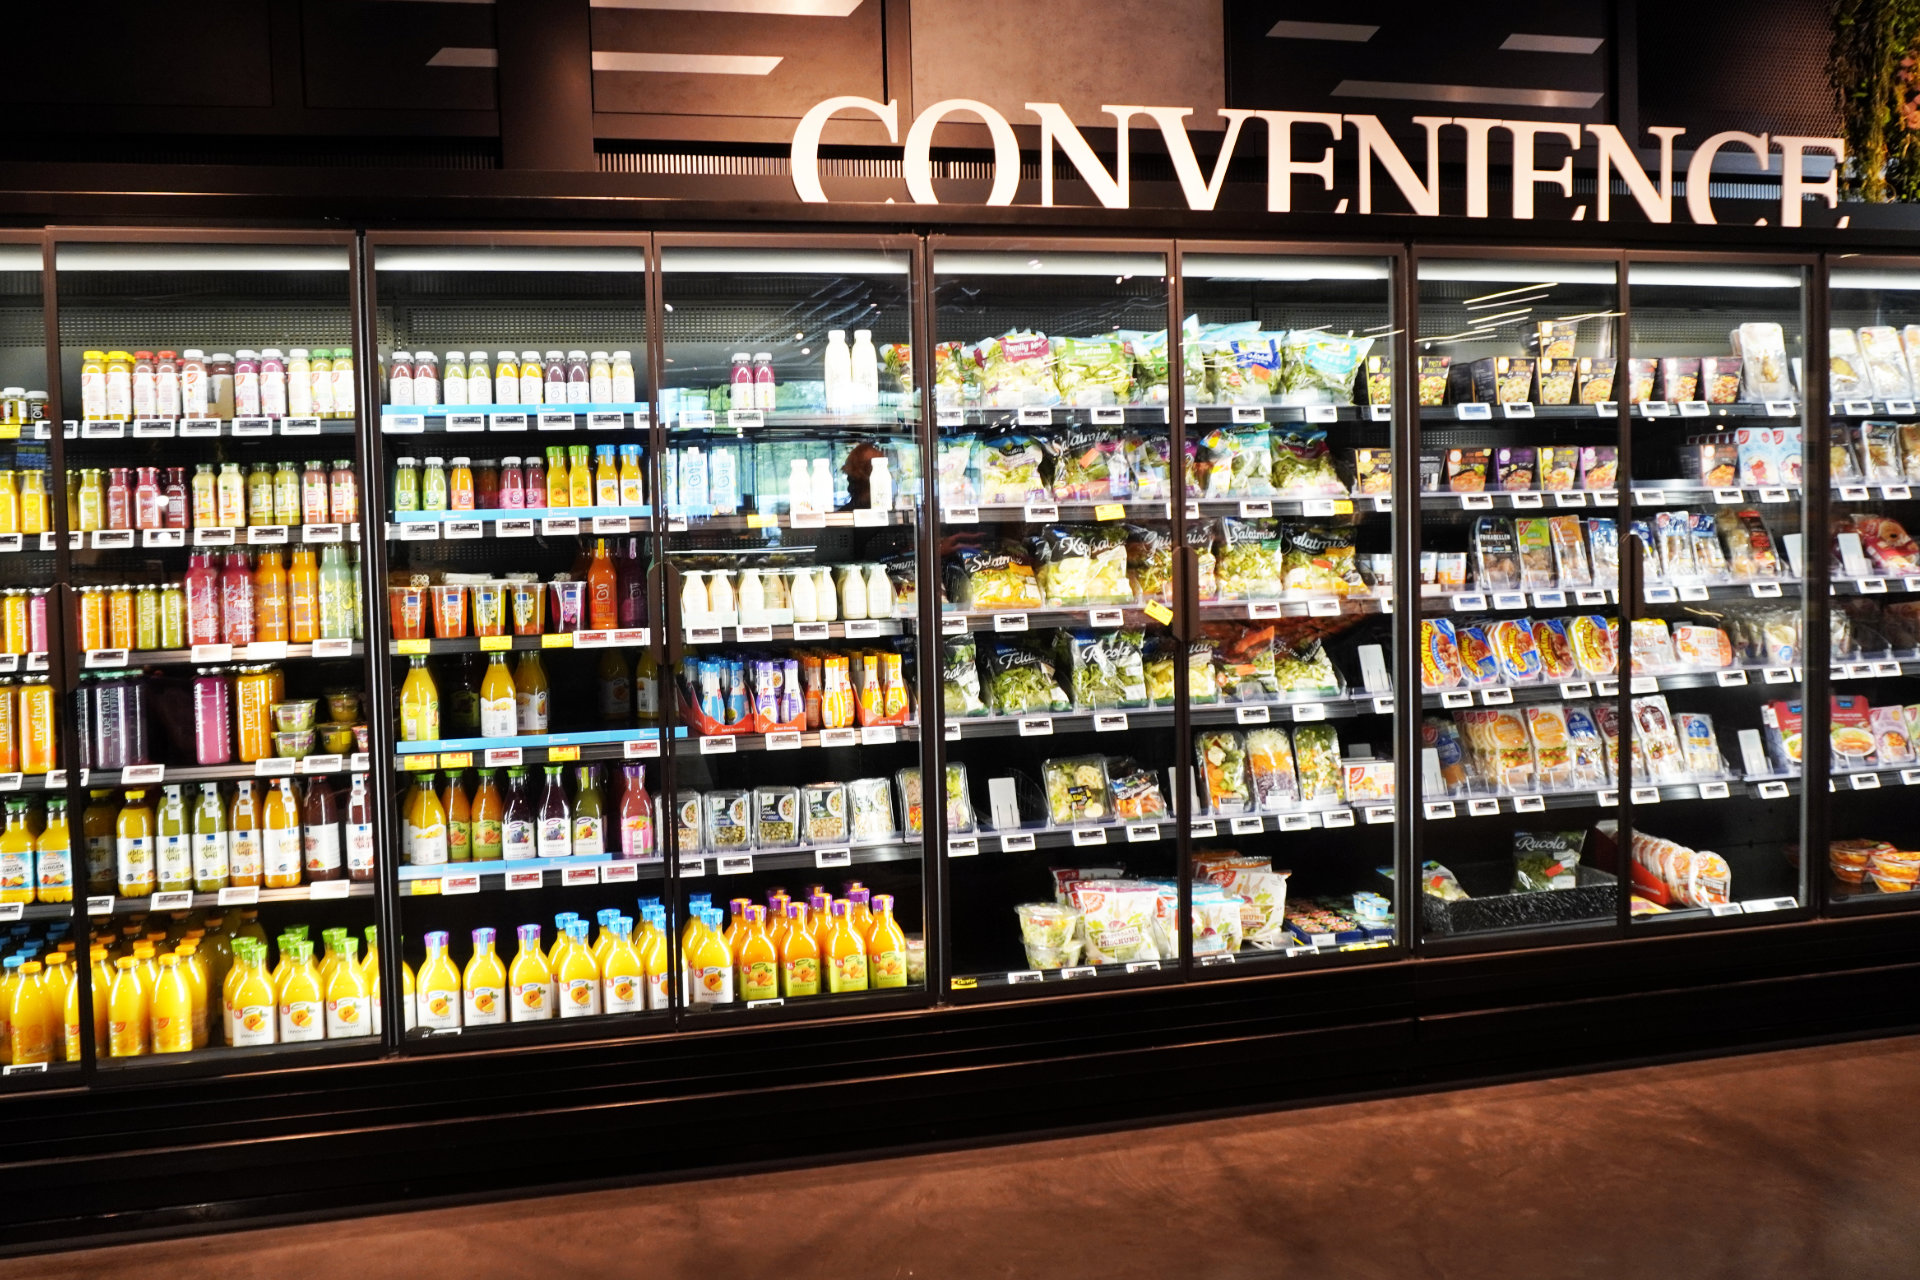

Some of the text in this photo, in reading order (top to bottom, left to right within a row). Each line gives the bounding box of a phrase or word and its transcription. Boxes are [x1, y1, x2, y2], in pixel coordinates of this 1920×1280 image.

[790, 95, 1848, 229] CONVENIENCE
[1005, 342, 1029, 353] Family
[1230, 526, 1277, 542] Salatmix
[32, 692, 42, 741] true fruits
[101, 689, 111, 737] true fruits
[242, 682, 253, 730] true fruits
[1516, 836, 1568, 852] Rucola
